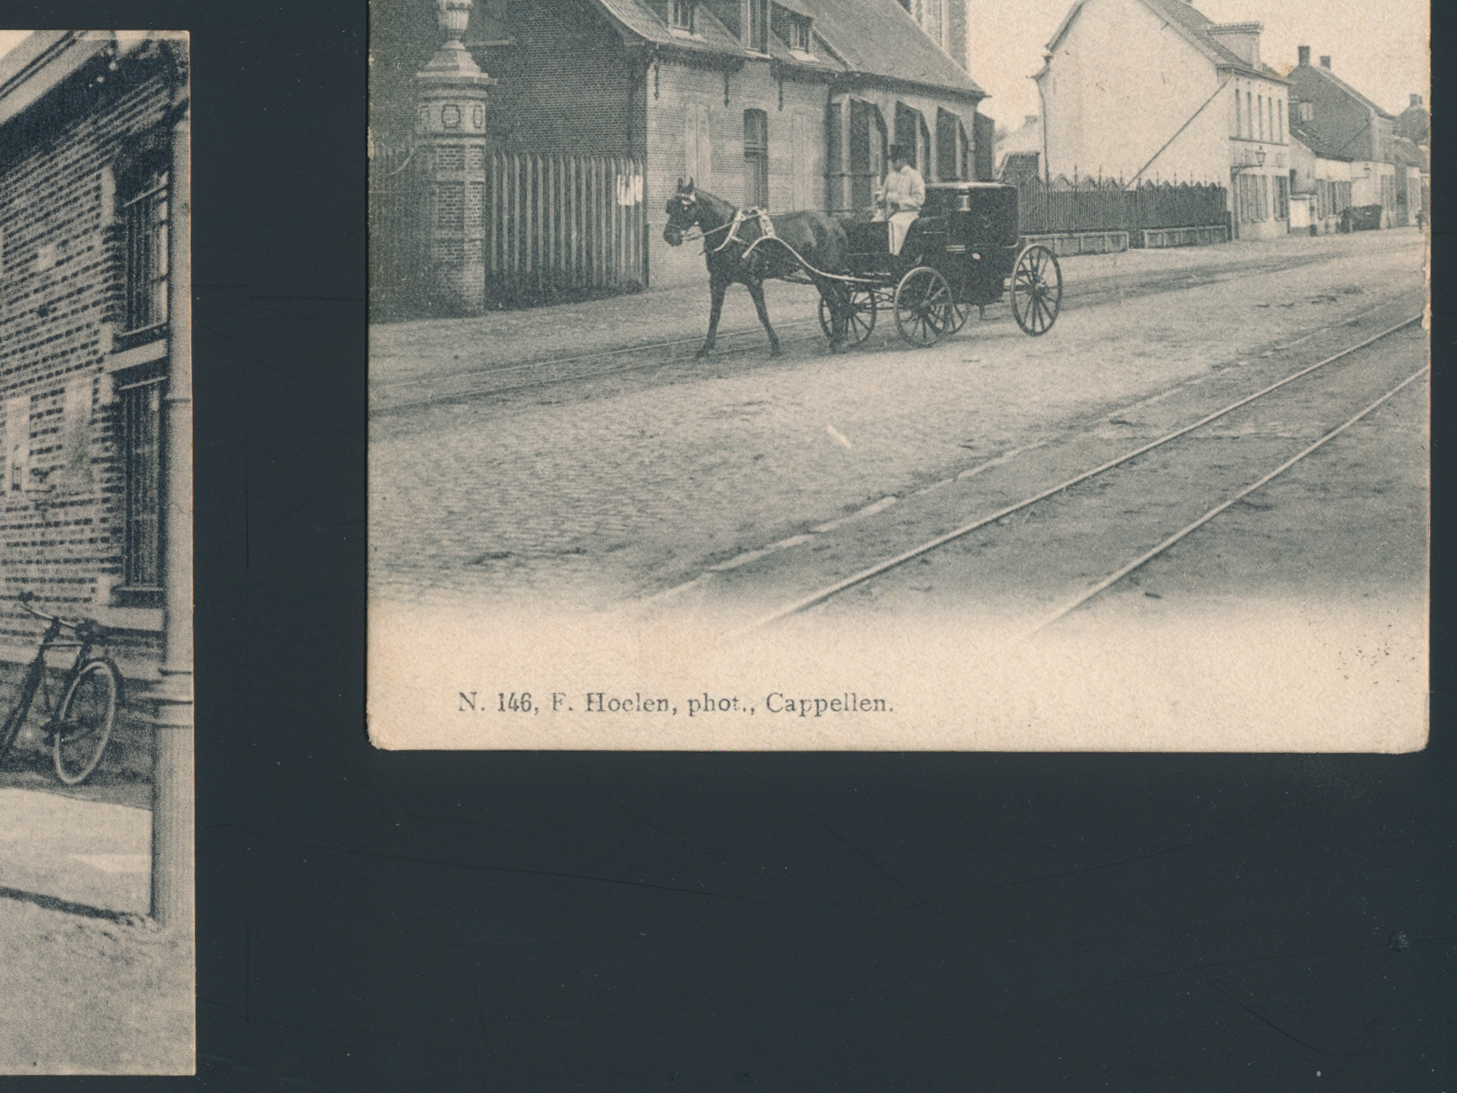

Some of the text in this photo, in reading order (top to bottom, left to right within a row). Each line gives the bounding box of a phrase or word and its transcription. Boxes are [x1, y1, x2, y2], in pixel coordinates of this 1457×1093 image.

[458, 691, 486, 712] N.
[497, 691, 539, 716] 146,
[552, 692, 574, 712] F.
[687, 692, 755, 718] phot.,
[765, 692, 894, 718] Cappellen.
